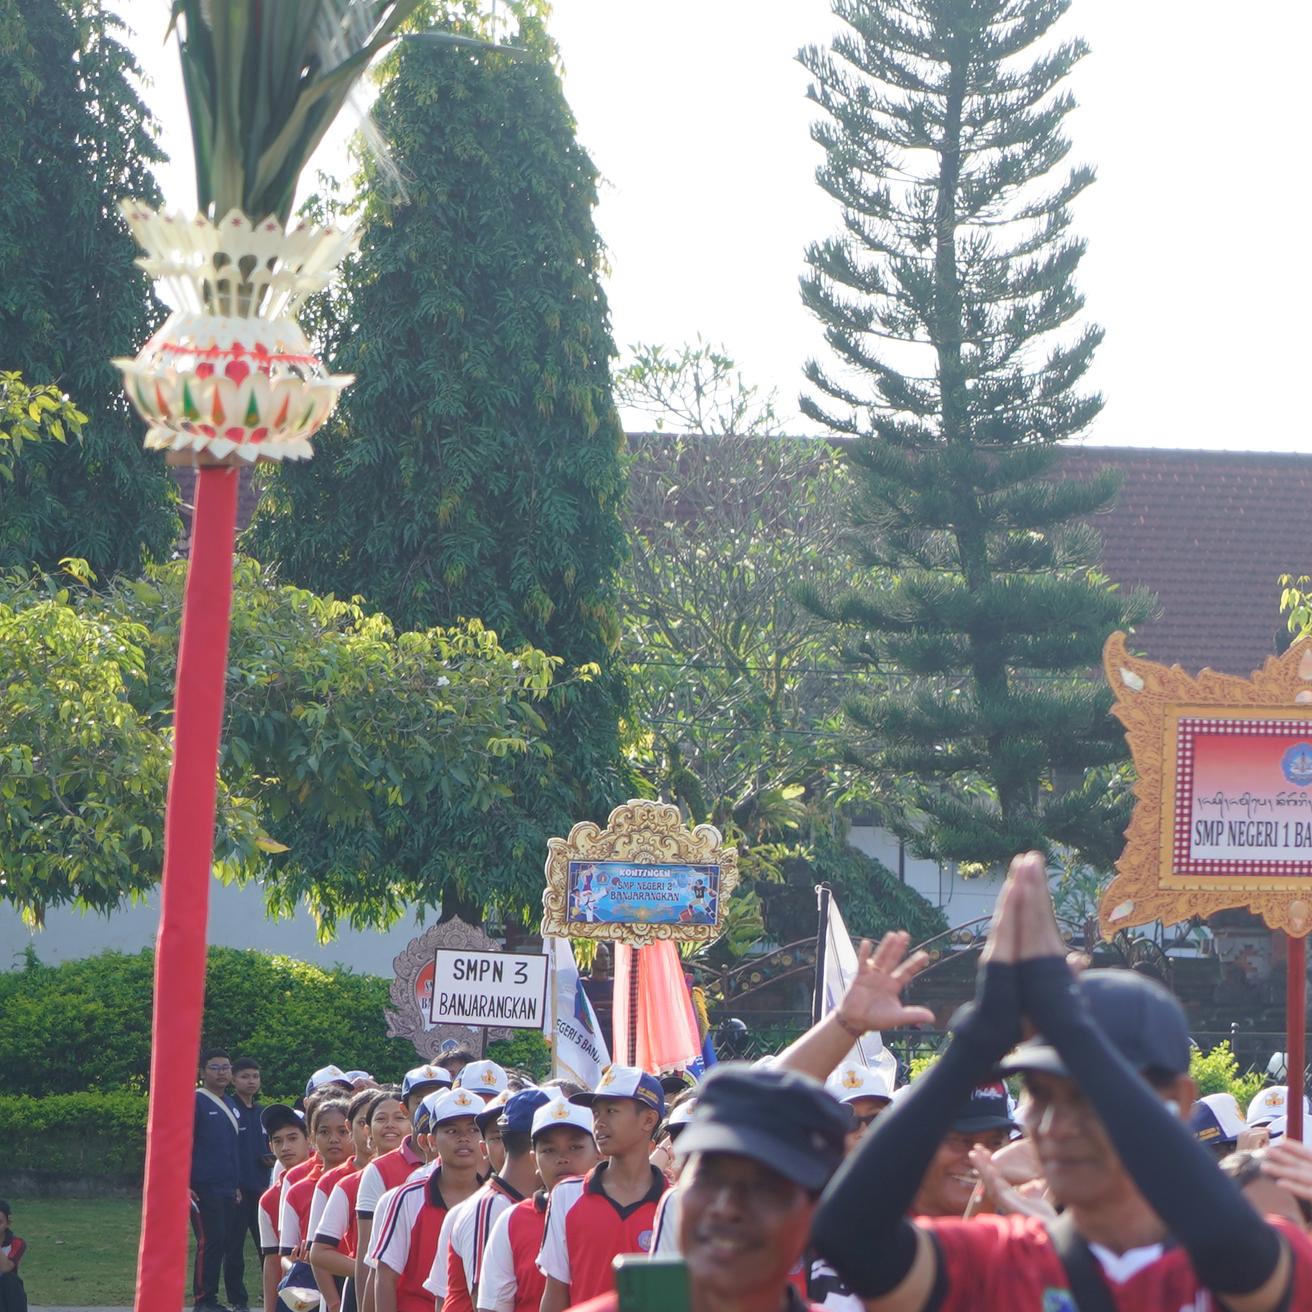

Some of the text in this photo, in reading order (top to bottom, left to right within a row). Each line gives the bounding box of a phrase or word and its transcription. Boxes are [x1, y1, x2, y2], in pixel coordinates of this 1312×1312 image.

[1194, 820, 1224, 846] SMP
[1227, 821, 1279, 847] NEGERI
[1283, 823, 1289, 847] 1
[619, 868, 671, 878] KONTINGEN
[618, 881, 634, 889] SMP
[637, 881, 664, 890] NEGERI
[610, 891, 679, 901] BANJARANGKAN
[453, 958, 529, 984] SMPN 3
[439, 993, 537, 1020] BANJARANGKAN
[575, 1035, 582, 1045] 5
